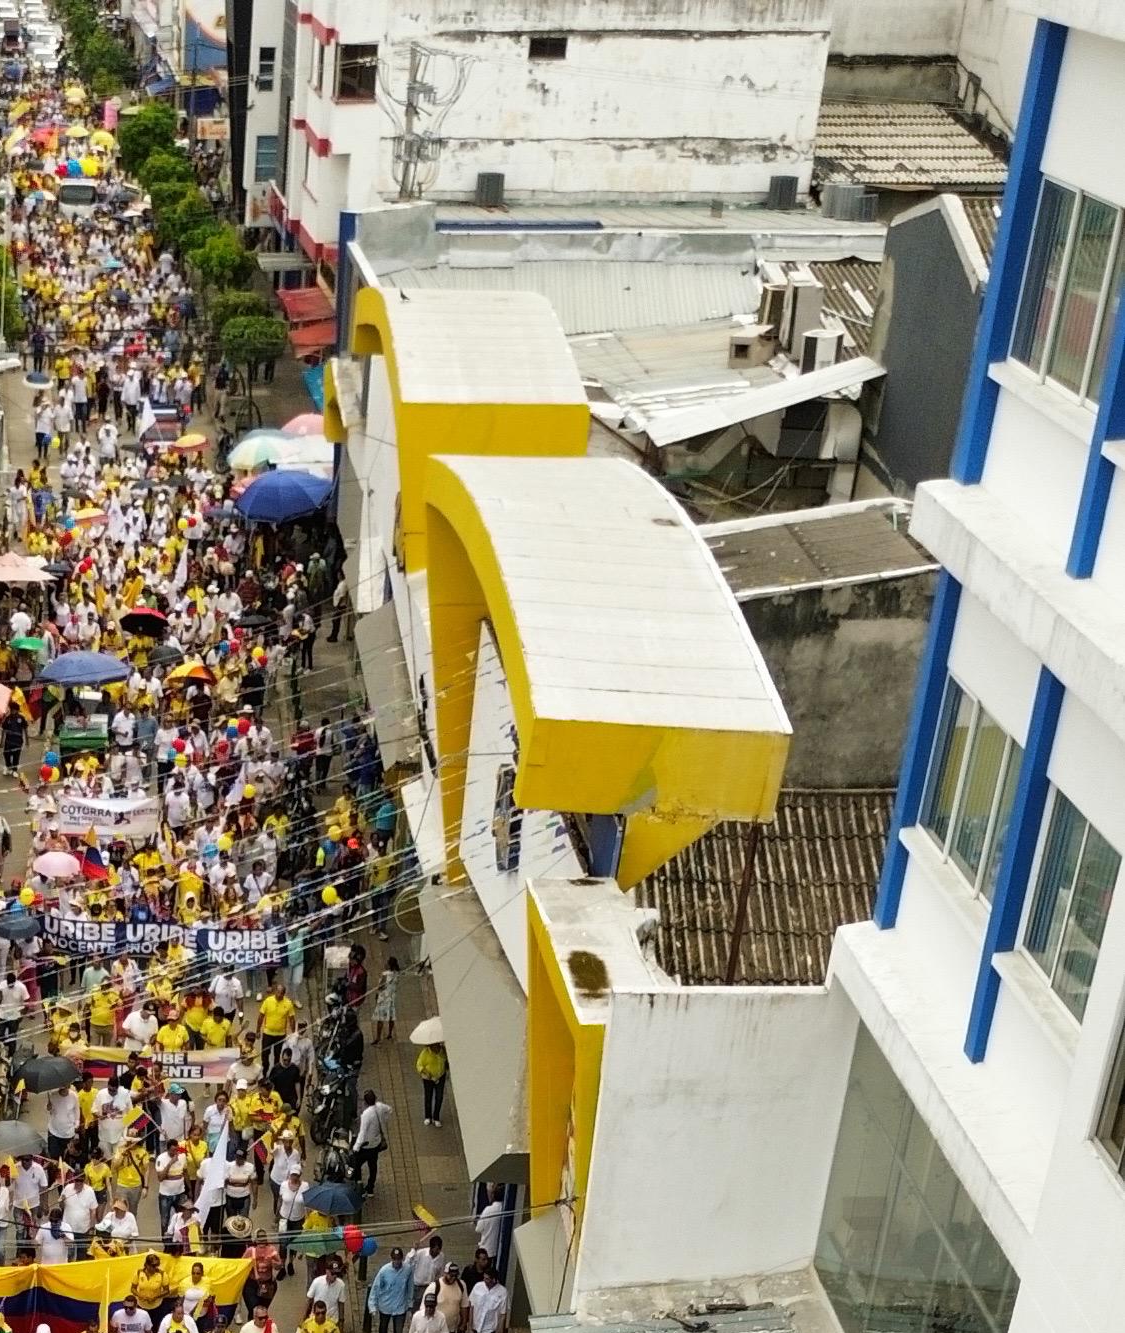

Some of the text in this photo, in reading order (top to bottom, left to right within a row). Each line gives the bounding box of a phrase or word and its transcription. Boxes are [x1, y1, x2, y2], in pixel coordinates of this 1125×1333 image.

[61, 804, 112, 818] COTORRA
[43, 932, 281, 965] INOCENTE INOC INOCENTE
[44, 915, 279, 951] URIBE URIBE URIBE
